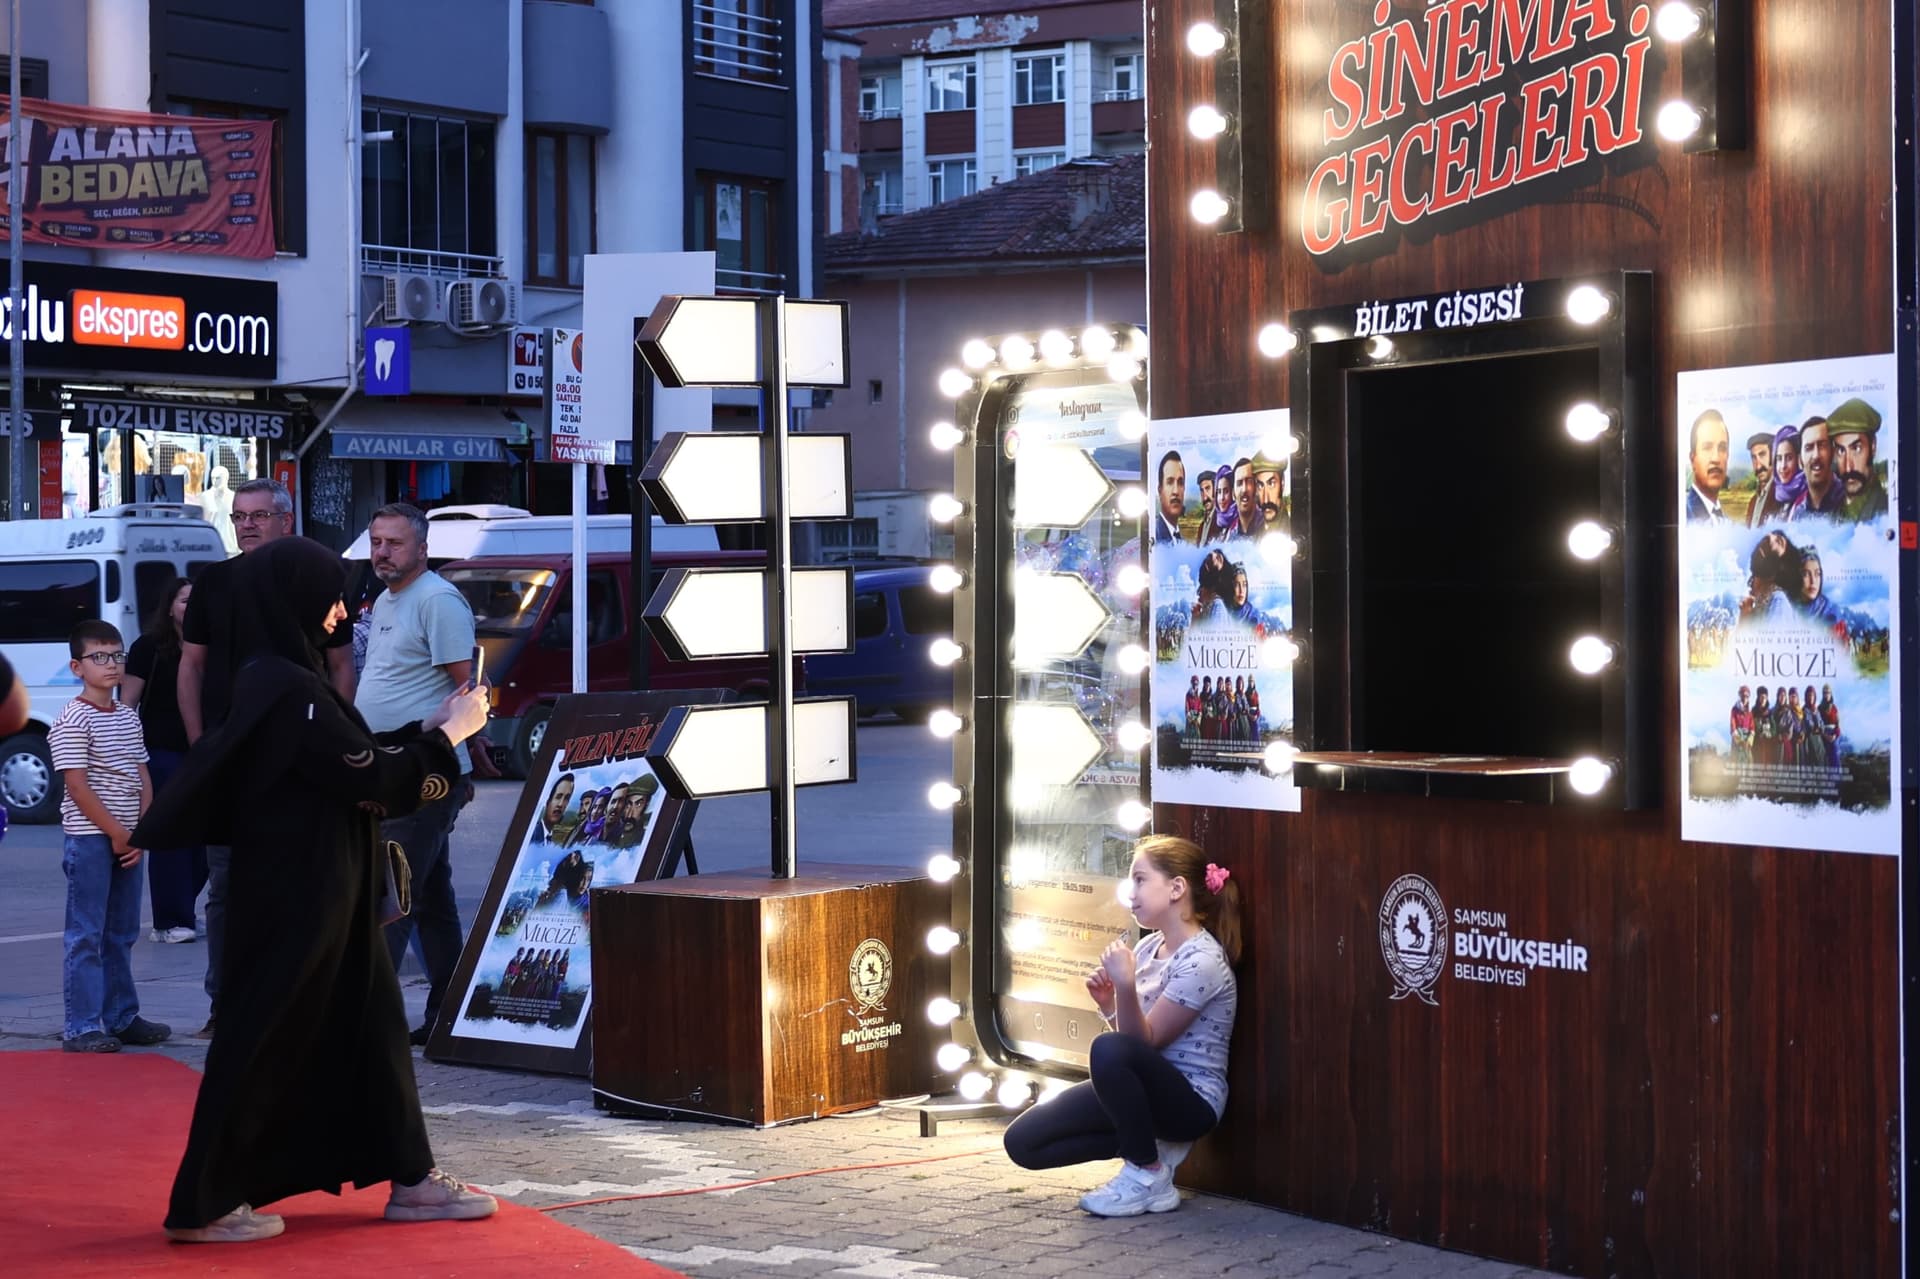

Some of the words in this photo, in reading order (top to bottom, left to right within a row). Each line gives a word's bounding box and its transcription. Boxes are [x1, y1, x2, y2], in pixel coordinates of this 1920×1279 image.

[48, 126, 198, 162] ALANA
[1300, 4, 1652, 256] GECELERİ
[40, 158, 210, 205] BEDAVA
[78, 296, 179, 344] ekspres
[1353, 300, 1429, 338] BİLET
[1434, 281, 1524, 327] GİŞESİ
[556, 383, 581, 394] 08.00
[83, 402, 167, 431] TOZLU
[175, 408, 284, 439] EKSPRES
[561, 404, 574, 413] TEK
[560, 425, 579, 433] FAZLA
[347, 437, 445, 456] AYANLAR
[613, 716, 663, 756] FİL
[1454, 908, 1506, 928] SAMSUN
[1454, 928, 1588, 972] BÜYÜKŞEHİR
[1454, 963, 1526, 987] BELEDİYESİ
[841, 1021, 902, 1045] BÜYÜKŞEHİR
[860, 1016, 884, 1027] SAMSUN
